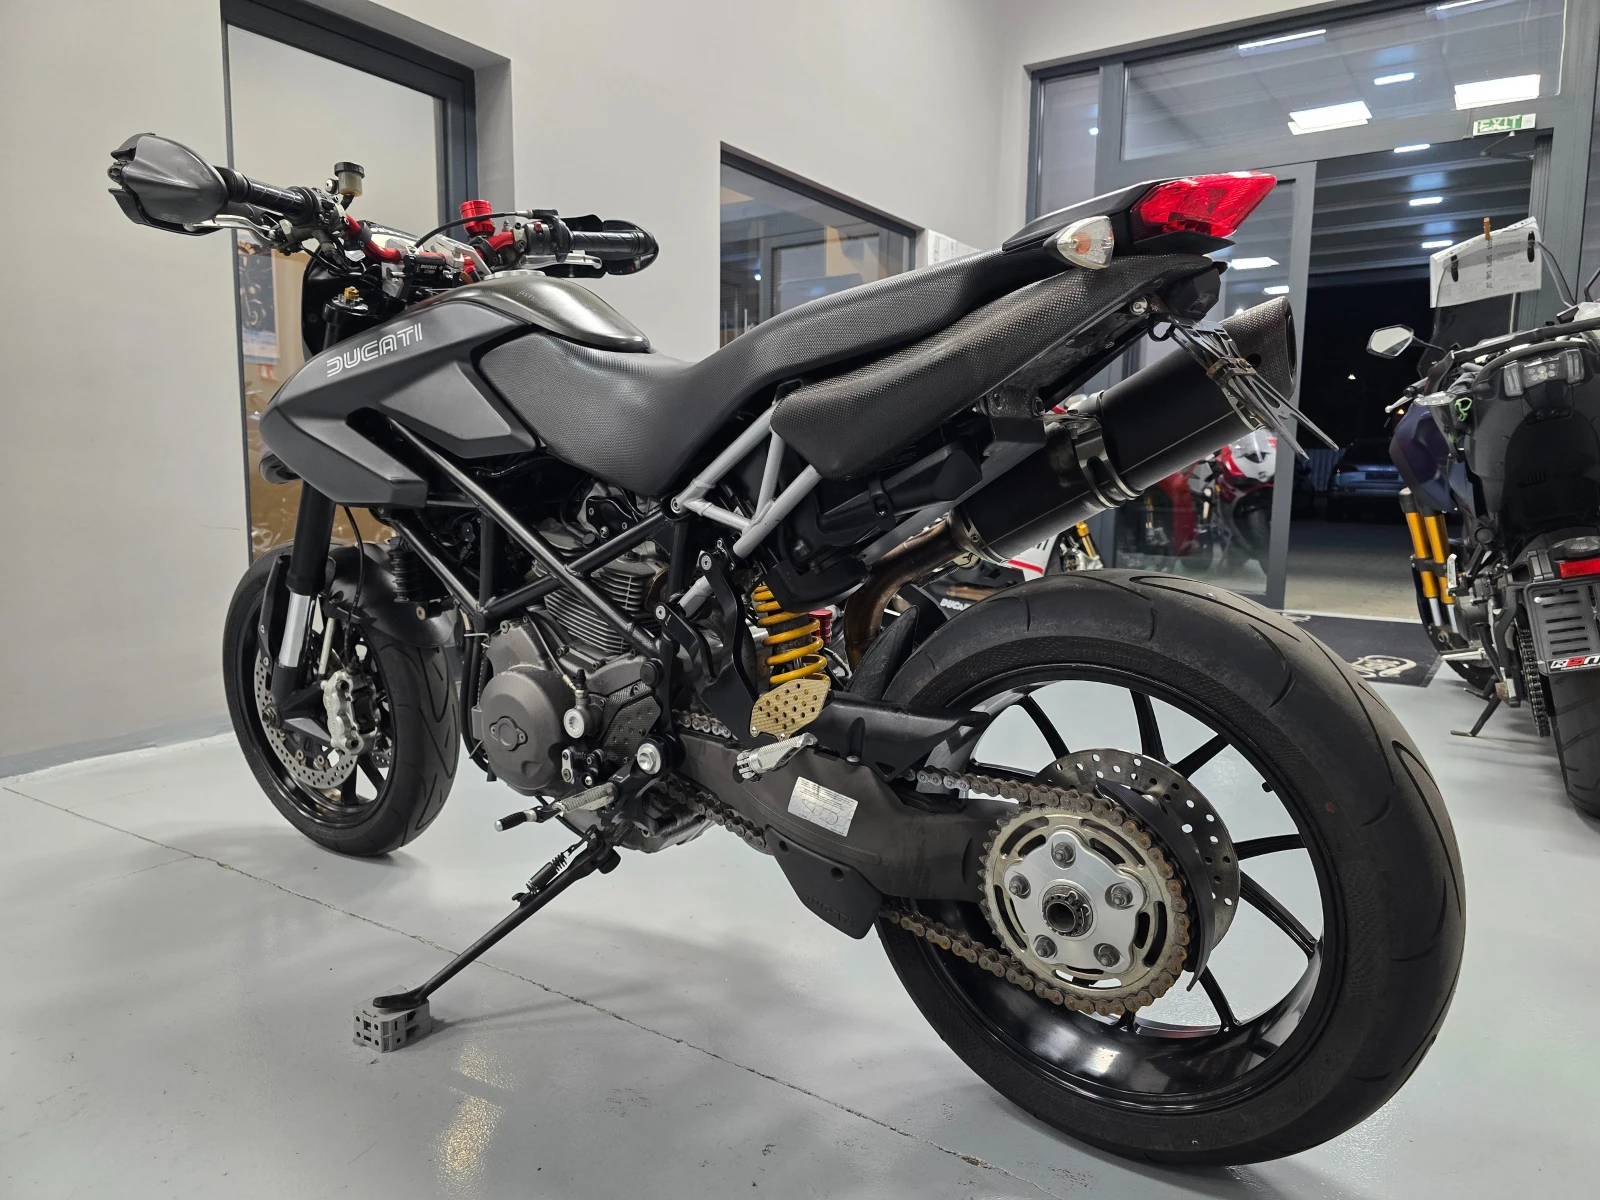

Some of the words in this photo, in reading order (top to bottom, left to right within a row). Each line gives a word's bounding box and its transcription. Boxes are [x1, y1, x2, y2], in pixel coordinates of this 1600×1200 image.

[1480, 114, 1521, 132] EXIT
[326, 322, 423, 378] DUCATI
[940, 597, 972, 611] DUCA
